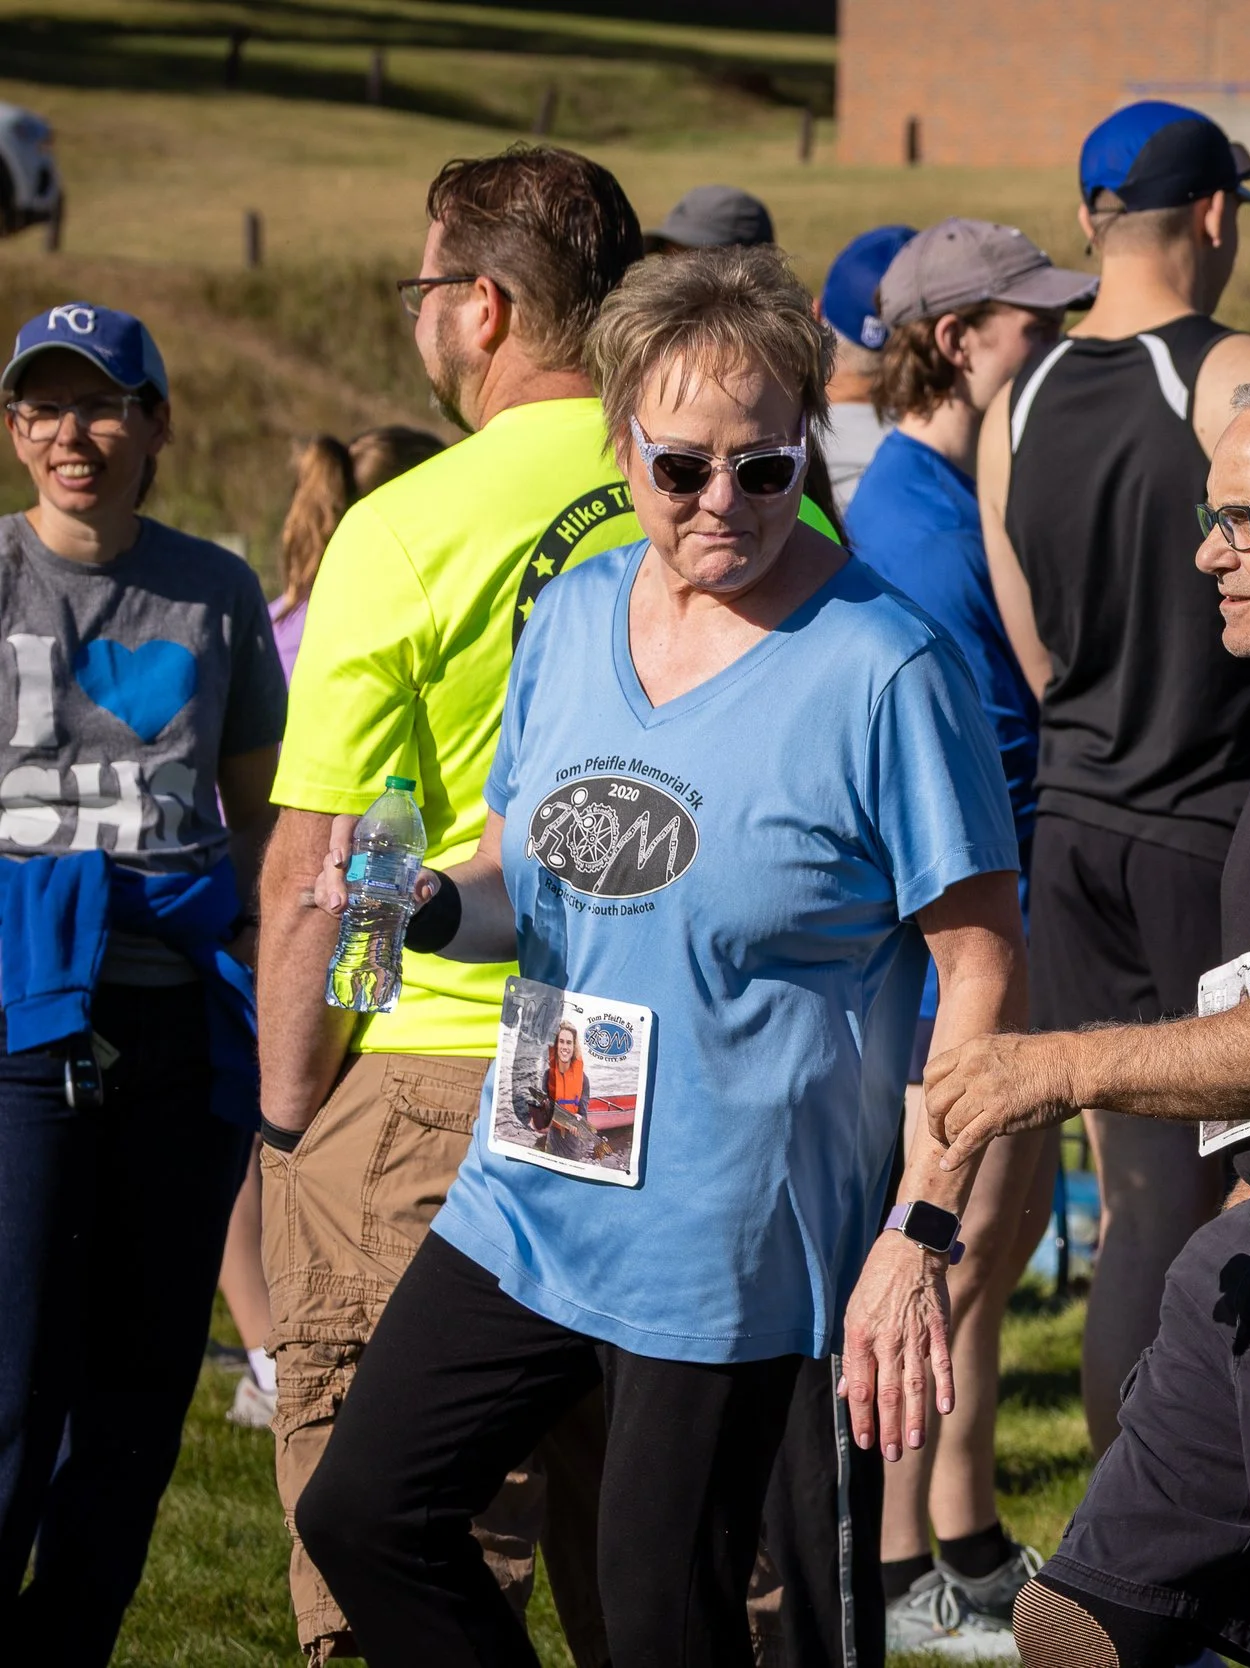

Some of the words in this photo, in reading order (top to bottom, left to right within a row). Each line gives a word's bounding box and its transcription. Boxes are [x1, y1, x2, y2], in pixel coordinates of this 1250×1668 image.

[48, 304, 95, 335] KC
[556, 499, 607, 544] Hike
[6, 633, 58, 747] I
[584, 755, 626, 773] Pfeifle
[628, 757, 690, 796] Memorial
[685, 789, 704, 812] 5k
[608, 783, 640, 802] 2020
[568, 895, 587, 913] City
[621, 900, 656, 916] Dakota
[587, 1015, 602, 1024] Tom
[625, 1021, 635, 1033] 5k
